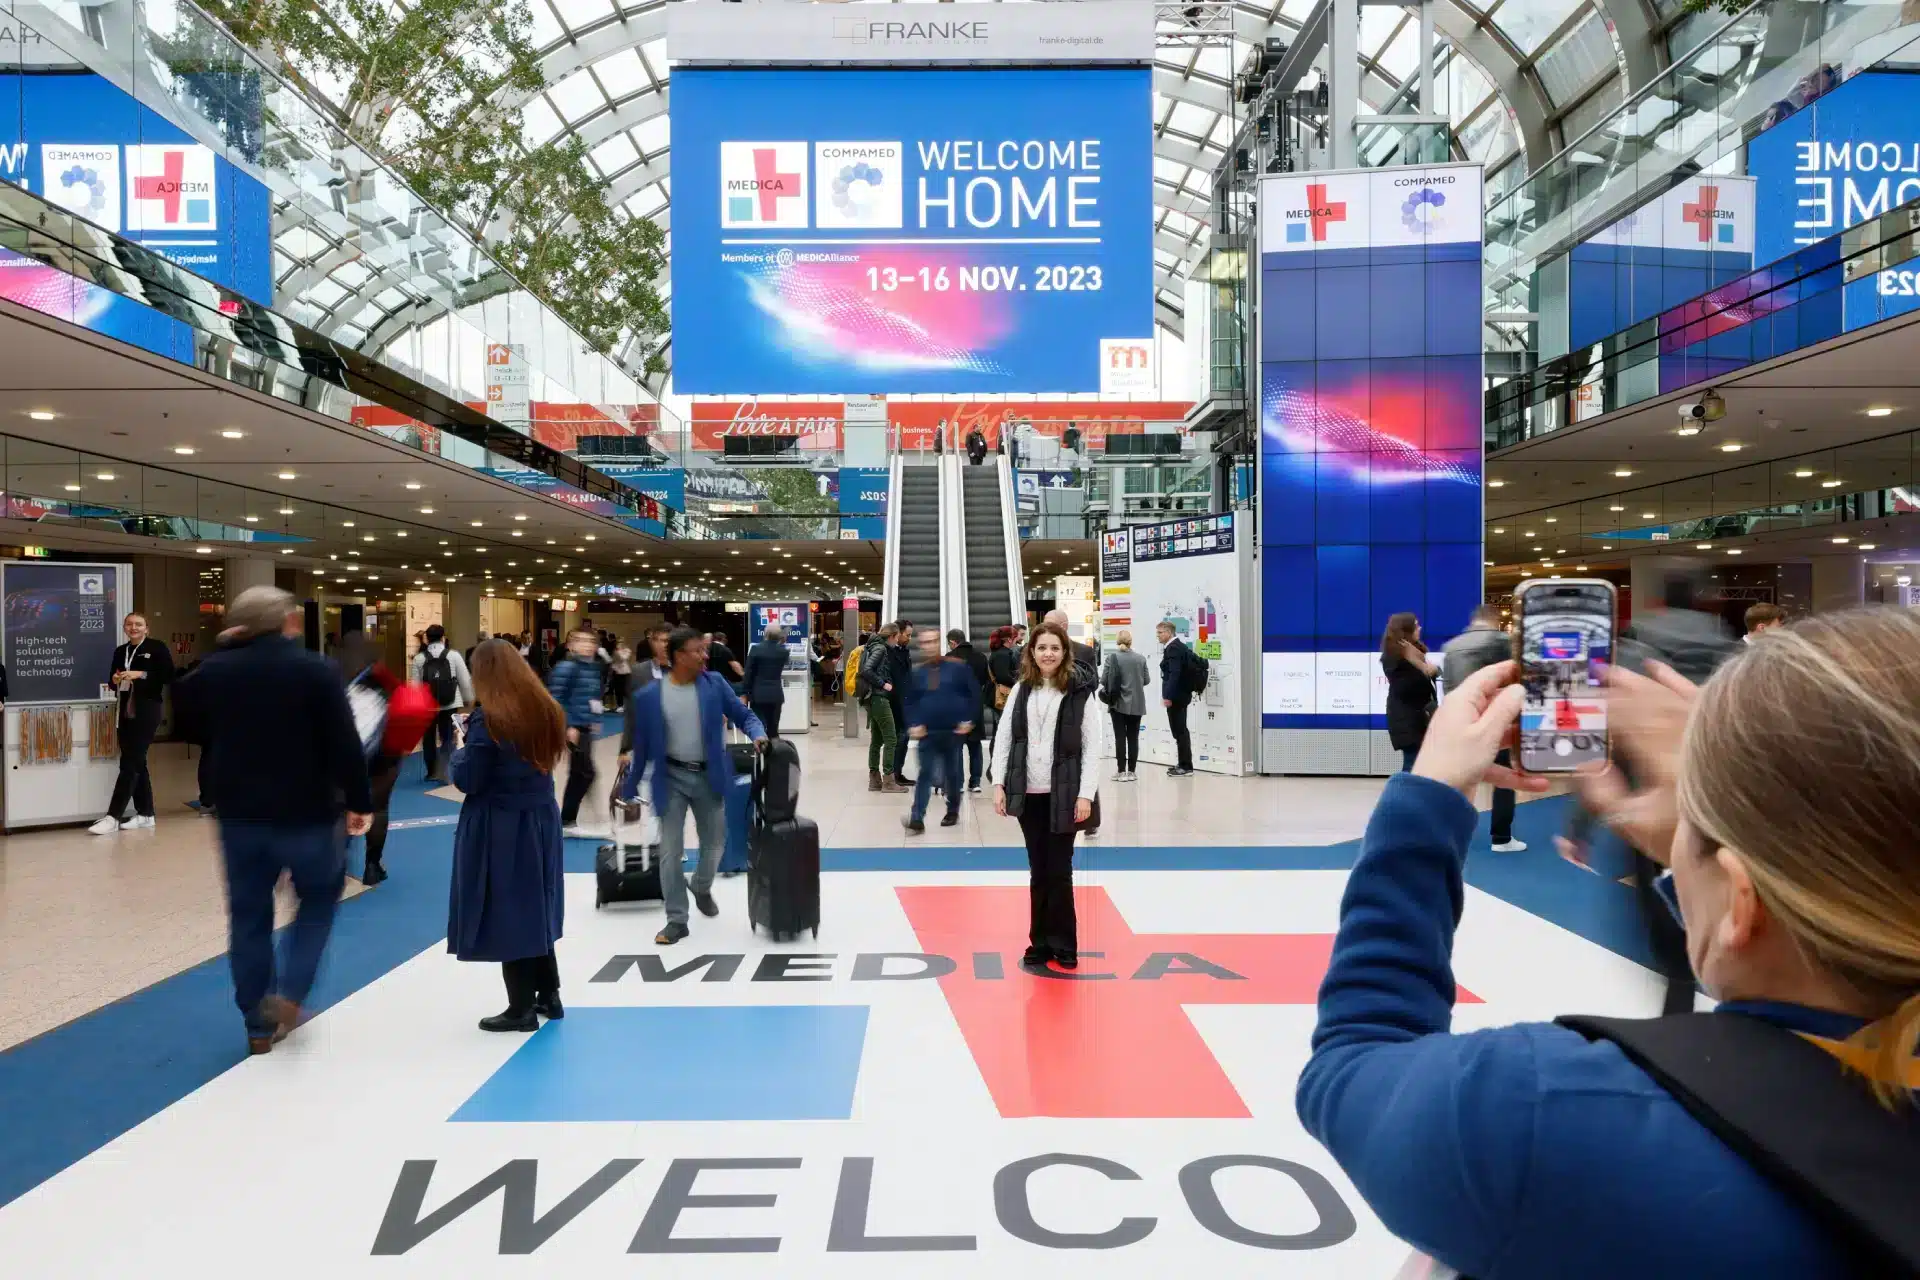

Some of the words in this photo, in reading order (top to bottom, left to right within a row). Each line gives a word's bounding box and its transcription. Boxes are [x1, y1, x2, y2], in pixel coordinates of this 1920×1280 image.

[869, 22, 989, 39] FRANKE
[1039, 36, 1104, 46] franke-digital.de
[822, 148, 896, 158] COMPAMED
[918, 141, 1101, 171] WELCOME
[728, 179, 784, 191] MEDICA
[1394, 175, 1456, 187] COMPAMED
[918, 176, 1101, 229] HOME
[1286, 207, 1333, 219] MEDICA
[721, 252, 763, 263] Members
[959, 266, 1026, 291] NOV.
[1035, 266, 1103, 291] 2023
[712, 402, 778, 439] Love
[779, 418, 792, 434] A
[795, 416, 836, 435] FAIR
[902, 426, 934, 434] business.
[79, 619, 105, 629] 2023
[15, 636, 67, 647] High-tech
[15, 646, 64, 656] solutions
[16, 657, 31, 666] for
[34, 656, 75, 666] medical
[16, 668, 73, 678] technology
[590, 952, 1250, 983] MEDICA
